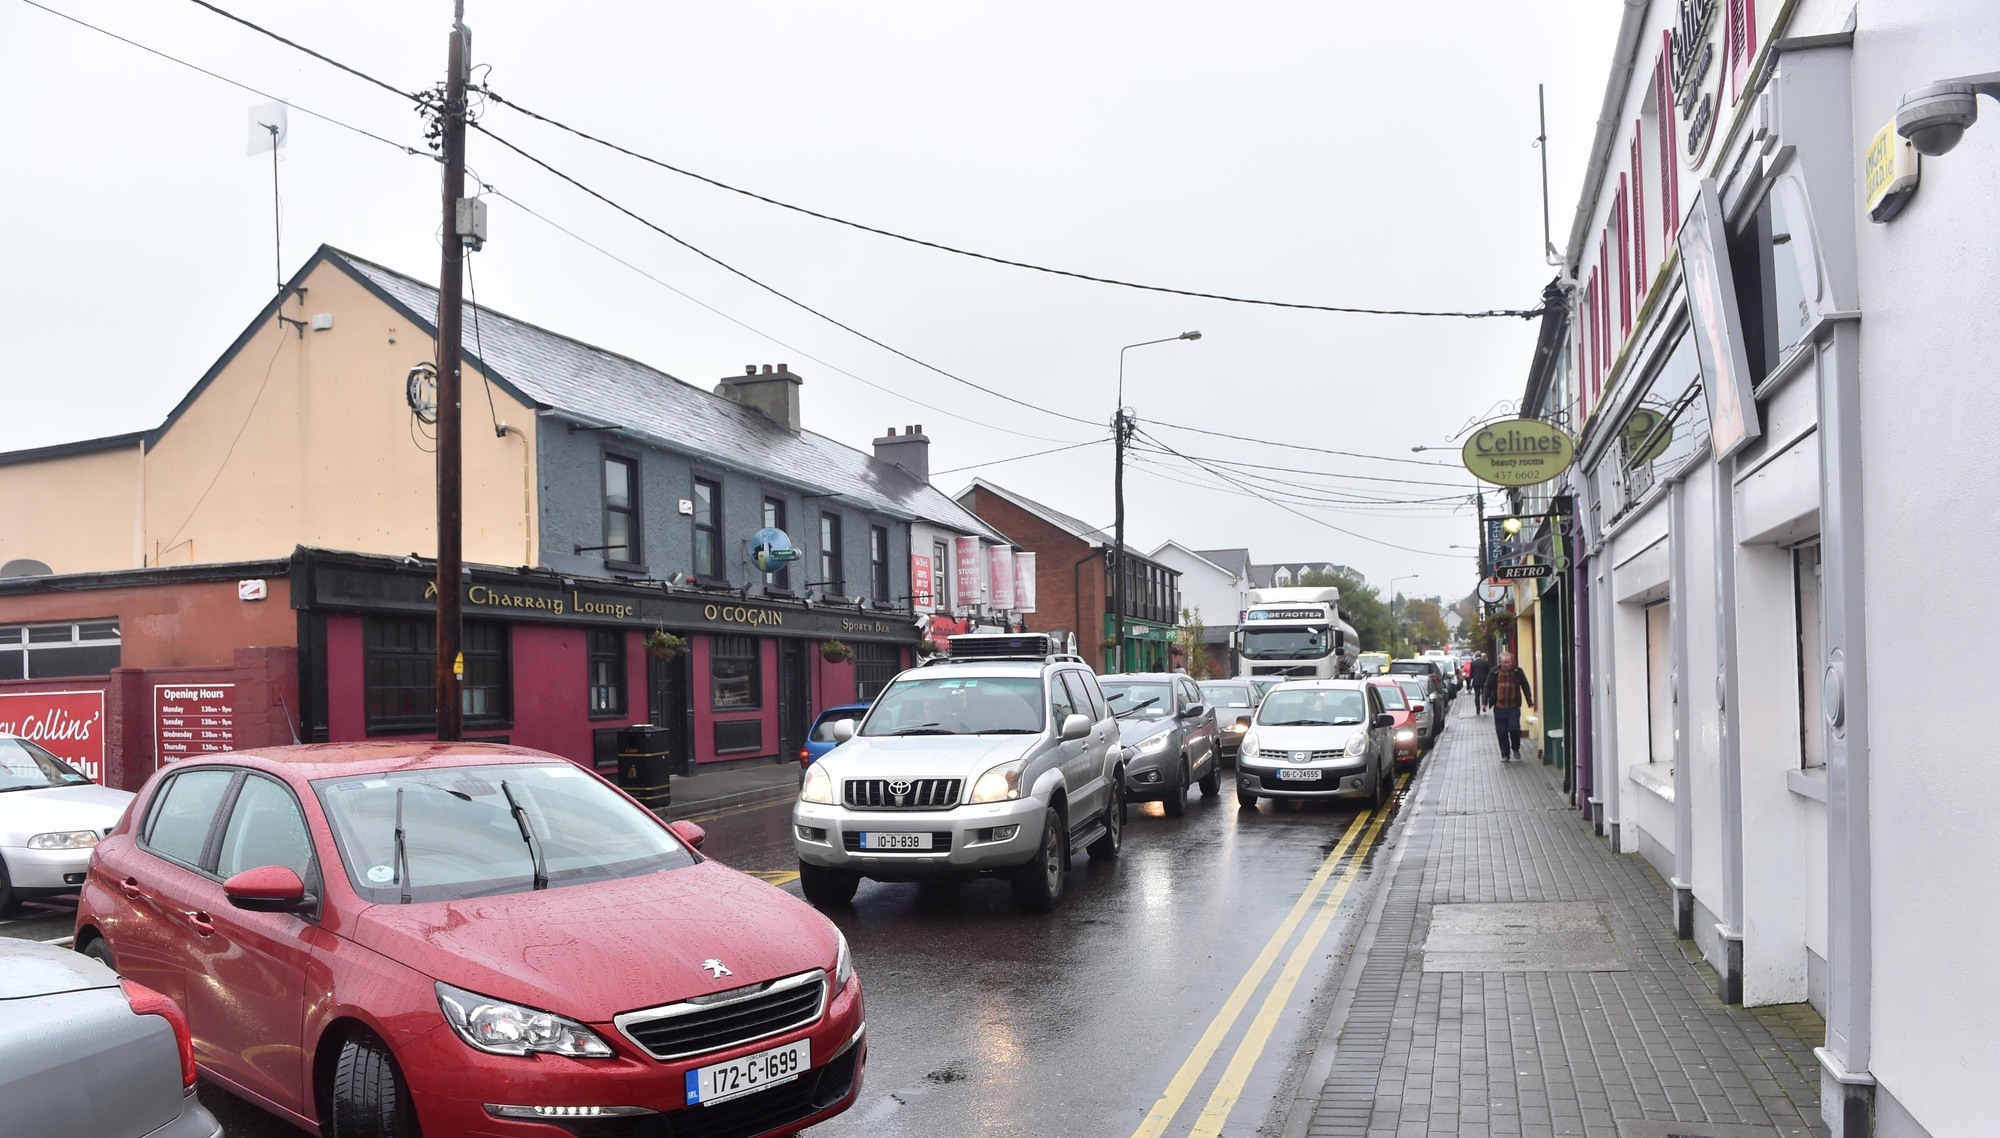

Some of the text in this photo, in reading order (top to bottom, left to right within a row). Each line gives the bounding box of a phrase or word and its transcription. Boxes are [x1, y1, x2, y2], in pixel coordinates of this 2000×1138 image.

[1476, 431, 1561, 453] Celines
[1491, 458, 1544, 468] beauty rooms
[1494, 470, 1540, 480] 437 6602
[1506, 566, 1545, 578] RETRO
[468, 586, 564, 615] Charraig
[573, 591, 633, 619] Lounge
[842, 617, 890, 633] Sports Bar
[164, 688, 224, 701] Opening Hours
[163, 706, 184, 714] Monday
[163, 718, 184, 727] Tuesday
[163, 731, 193, 739] Wednesday
[164, 743, 187, 752] Thursday
[1282, 770, 1319, 778] 06-C-24555
[877, 836, 919, 848] 10-D-838
[713, 1048, 798, 1094] 172-C-1699
[687, 1091, 698, 1099] IRL
